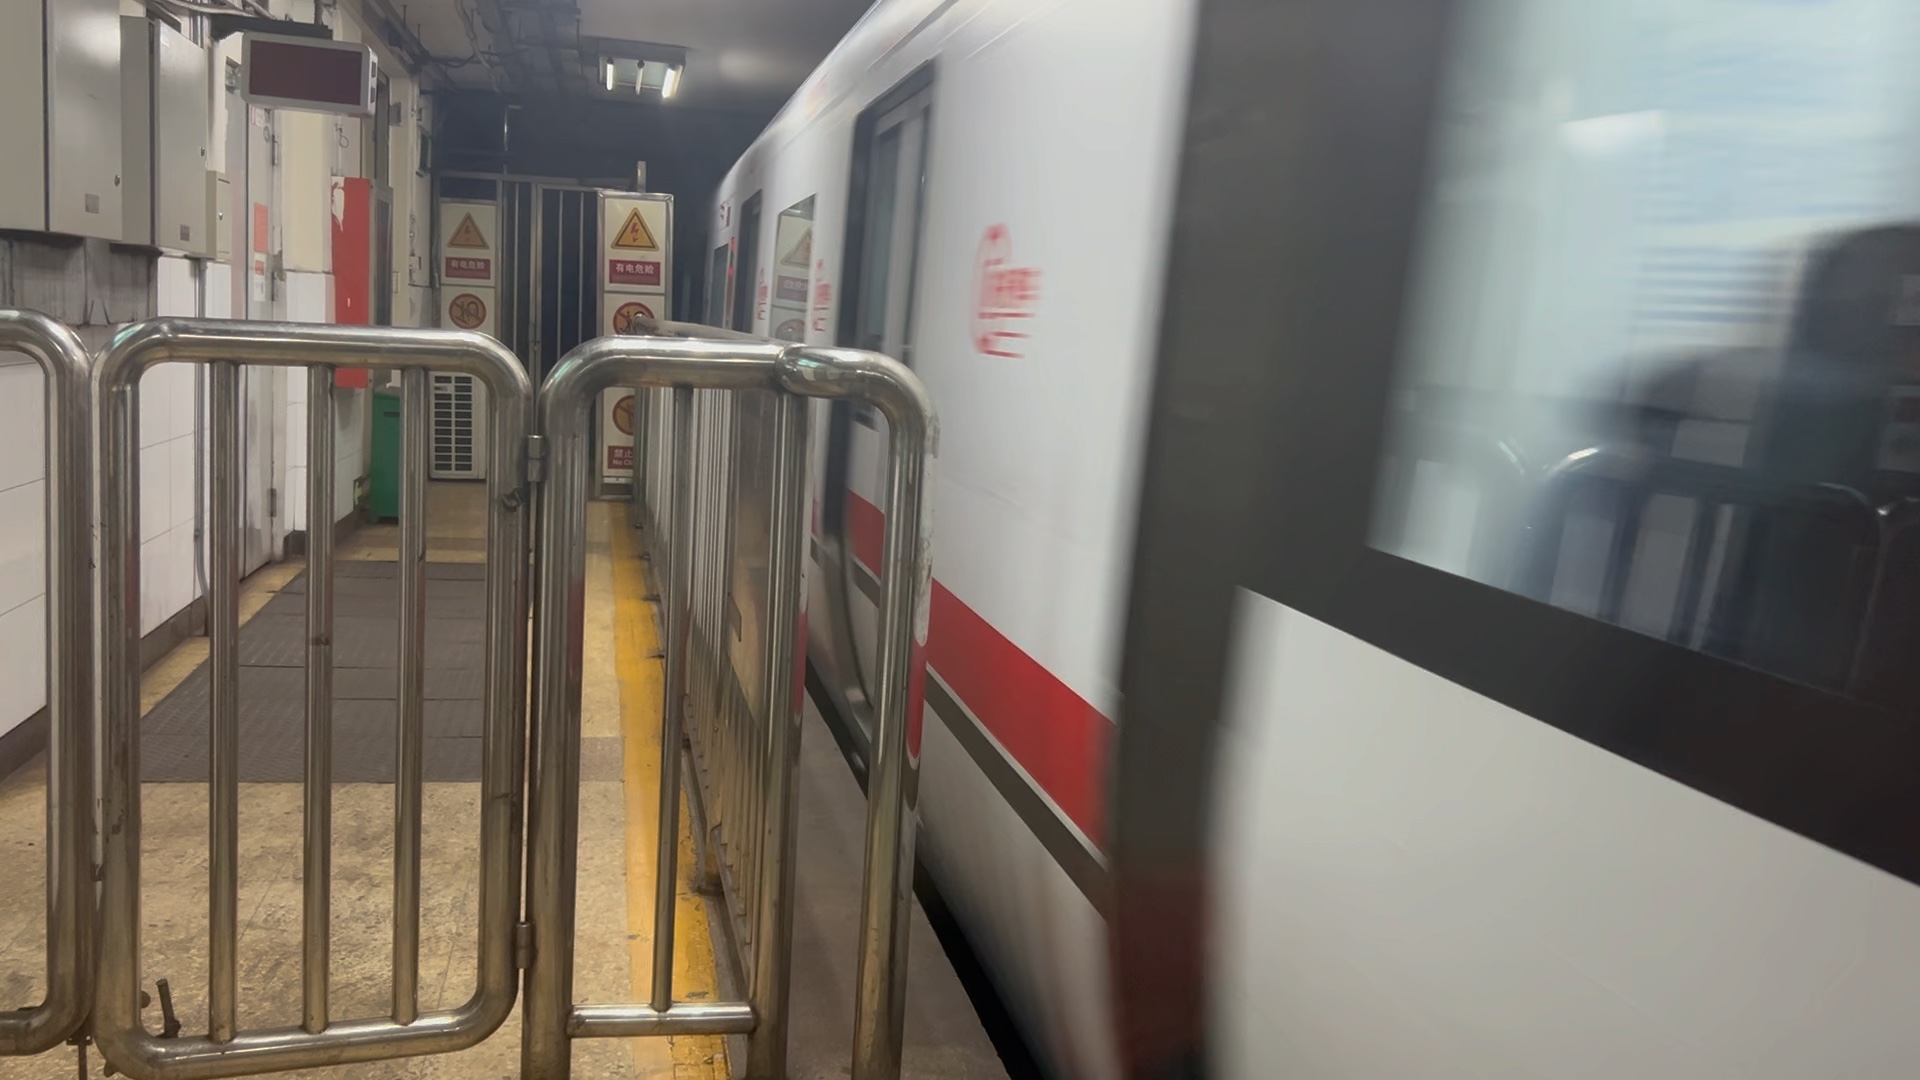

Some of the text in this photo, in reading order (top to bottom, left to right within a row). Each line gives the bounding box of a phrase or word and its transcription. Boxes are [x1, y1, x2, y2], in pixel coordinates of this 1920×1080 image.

[450, 259, 486, 270] 有电危险
[615, 262, 655, 275] 有电危险
